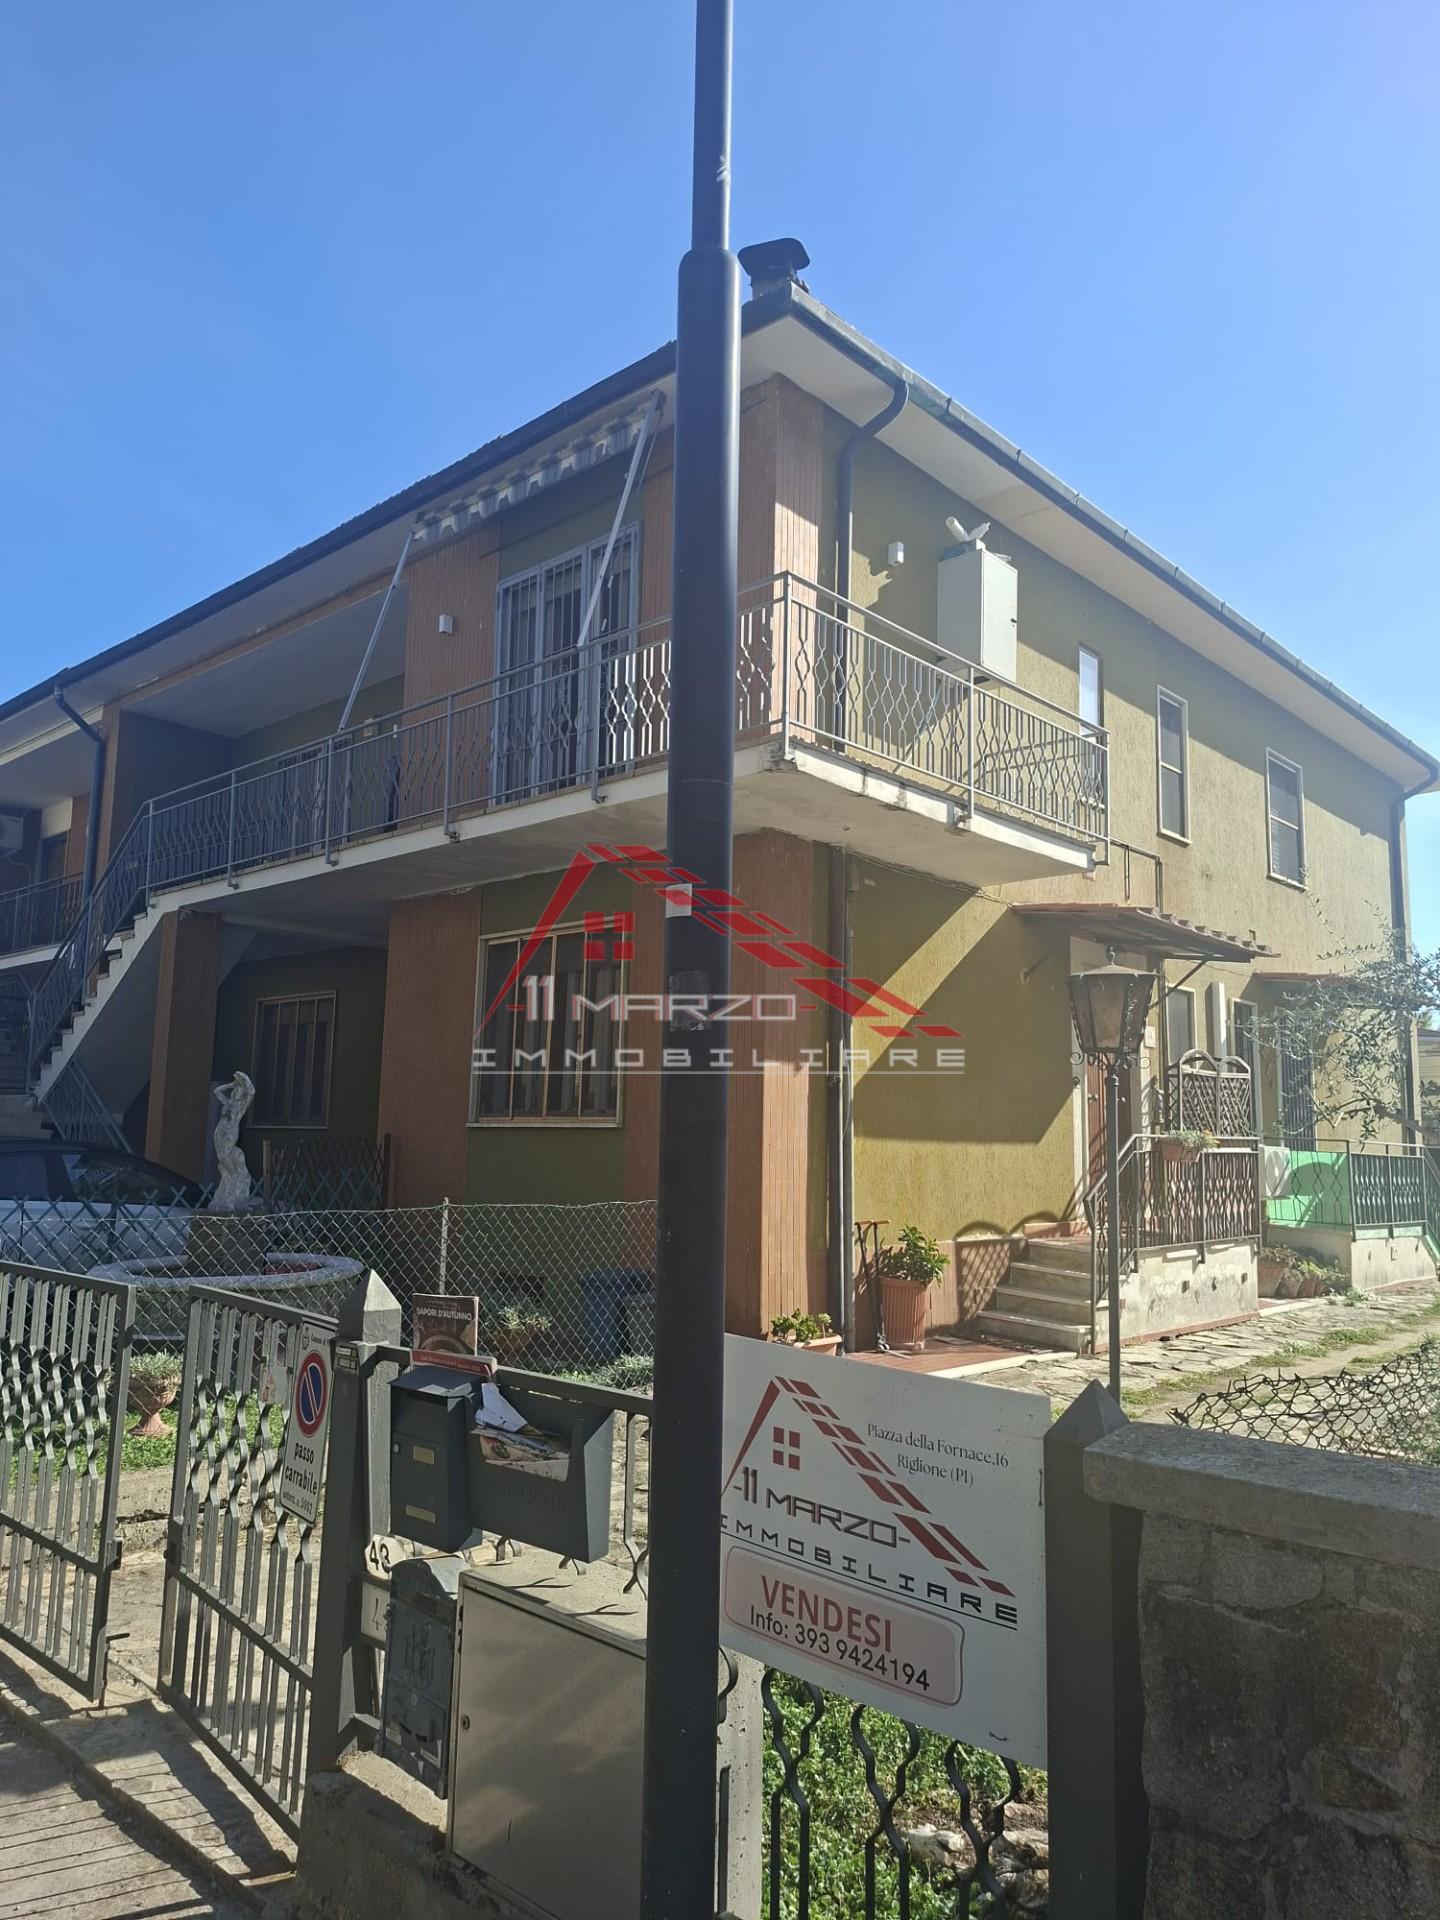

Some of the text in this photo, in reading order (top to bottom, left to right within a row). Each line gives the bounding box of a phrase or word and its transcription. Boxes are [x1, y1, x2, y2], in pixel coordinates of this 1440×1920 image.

[293, 1442, 315, 1465] passo
[867, 1423, 902, 1443] Piazza
[905, 1431, 934, 1451] della
[284, 1465, 318, 1496] carrabile
[897, 1453, 974, 1488] Riglione (PI)
[369, 1540, 391, 1574] 43
[761, 1574, 892, 1653] VENDESI
[750, 1604, 930, 1691] Info: 393 9424194
